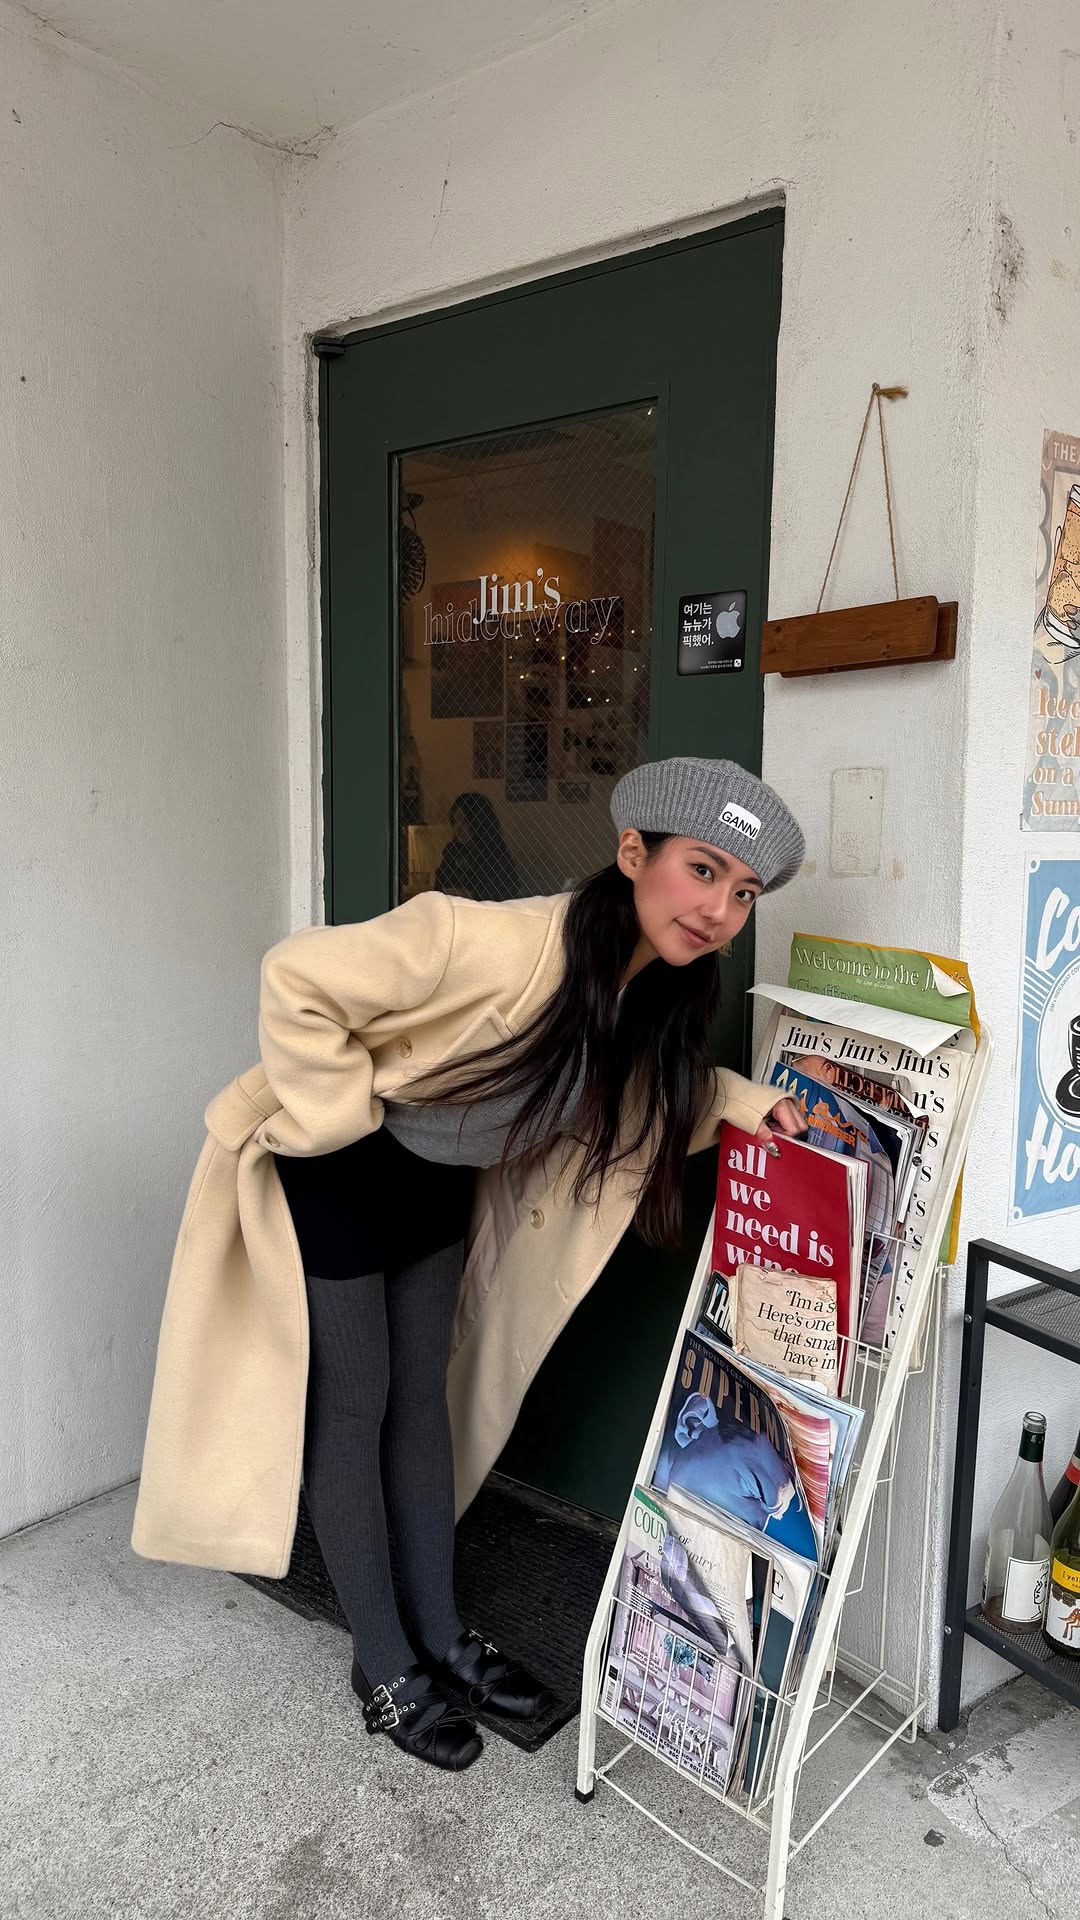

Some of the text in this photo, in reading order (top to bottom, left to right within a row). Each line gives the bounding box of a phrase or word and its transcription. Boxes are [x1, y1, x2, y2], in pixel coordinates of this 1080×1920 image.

[1053, 441, 1076, 462] THE
[473, 567, 561, 624] Jim's
[683, 602, 712, 616] 여기는
[682, 617, 712, 632] 뉴뉴가
[682, 633, 714, 647] 픽했어.
[1036, 687, 1068, 719] Ice
[1033, 767, 1074, 786] on a
[722, 811, 758, 838] GANNI
[795, 947, 871, 976] Welcome
[875, 963, 891, 980] to
[893, 964, 920, 986] the
[781, 1026, 950, 1080] Jim's Jim's Jim's
[727, 1143, 768, 1179] all
[728, 1178, 771, 1211] we
[725, 1208, 834, 1267] need is
[757, 1302, 835, 1332] Here's one
[814, 1302, 823, 1312] a
[773, 1325, 837, 1351] that sma
[689, 1338, 702, 1351] THE
[703, 1347, 730, 1373] WORLD'S
[730, 1370, 760, 1397] GREATEST
[783, 1344, 818, 1368] have
